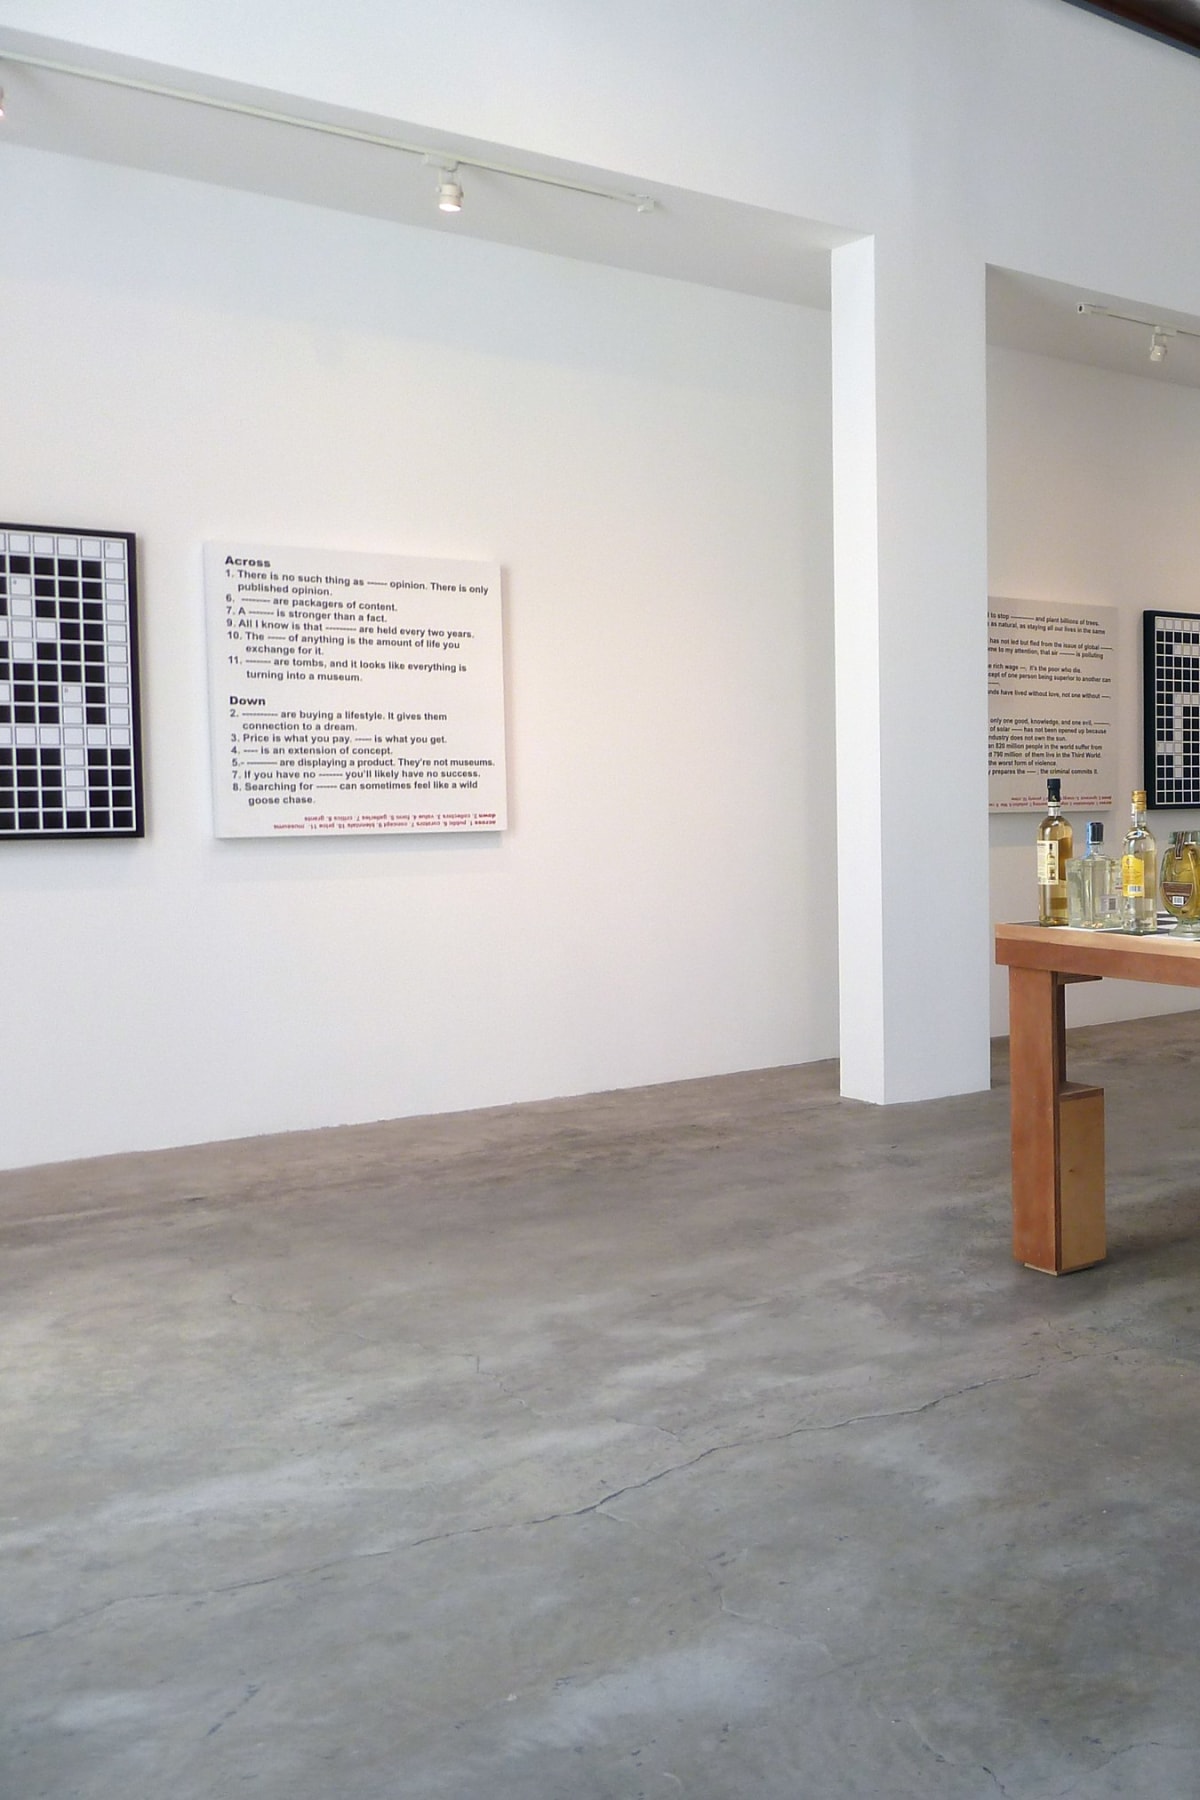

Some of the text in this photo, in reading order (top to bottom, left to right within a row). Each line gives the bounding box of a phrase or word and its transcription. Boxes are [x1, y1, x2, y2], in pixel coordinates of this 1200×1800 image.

[225, 555, 271, 567] Across
[238, 569, 267, 580] There
[298, 575, 322, 584] such
[325, 576, 350, 587] thing
[430, 582, 456, 591] There
[469, 585, 489, 596] only
[238, 582, 289, 593] published
[292, 598, 343, 610] packagers
[288, 610, 331, 621] stronger
[334, 612, 356, 621] than
[238, 619, 252, 628] All
[261, 619, 289, 630] know
[303, 622, 323, 631] that
[377, 625, 397, 634] held
[400, 628, 425, 638] every
[427, 628, 445, 636] two
[246, 631, 440, 648] The anything amount life
[245, 644, 312, 656] exchange for
[330, 659, 348, 668] and
[360, 660, 386, 669] looks
[389, 661, 405, 669] like
[408, 663, 456, 673] everything
[246, 670, 284, 681] turning
[287, 670, 306, 680] into
[230, 695, 266, 705] Down
[299, 710, 333, 721] buying
[396, 712, 421, 722] gives
[424, 712, 447, 720] them
[242, 722, 300, 730] connection
[243, 733, 269, 742] Price
[284, 734, 308, 742] what
[385, 735, 408, 743] what
[988, 734, 1009, 742] ndustry
[288, 746, 337, 754] extension
[297, 758, 347, 769] displaying
[433, 758, 448, 766] not
[276, 770, 300, 778] have
[374, 769, 399, 780] likely
[245, 782, 296, 793] Searching
[299, 782, 313, 790] for
[360, 781, 411, 789] sometimes
[414, 781, 431, 789] feel
[433, 781, 449, 789] like
[459, 780, 478, 789] wild
[248, 797, 280, 807] goose
